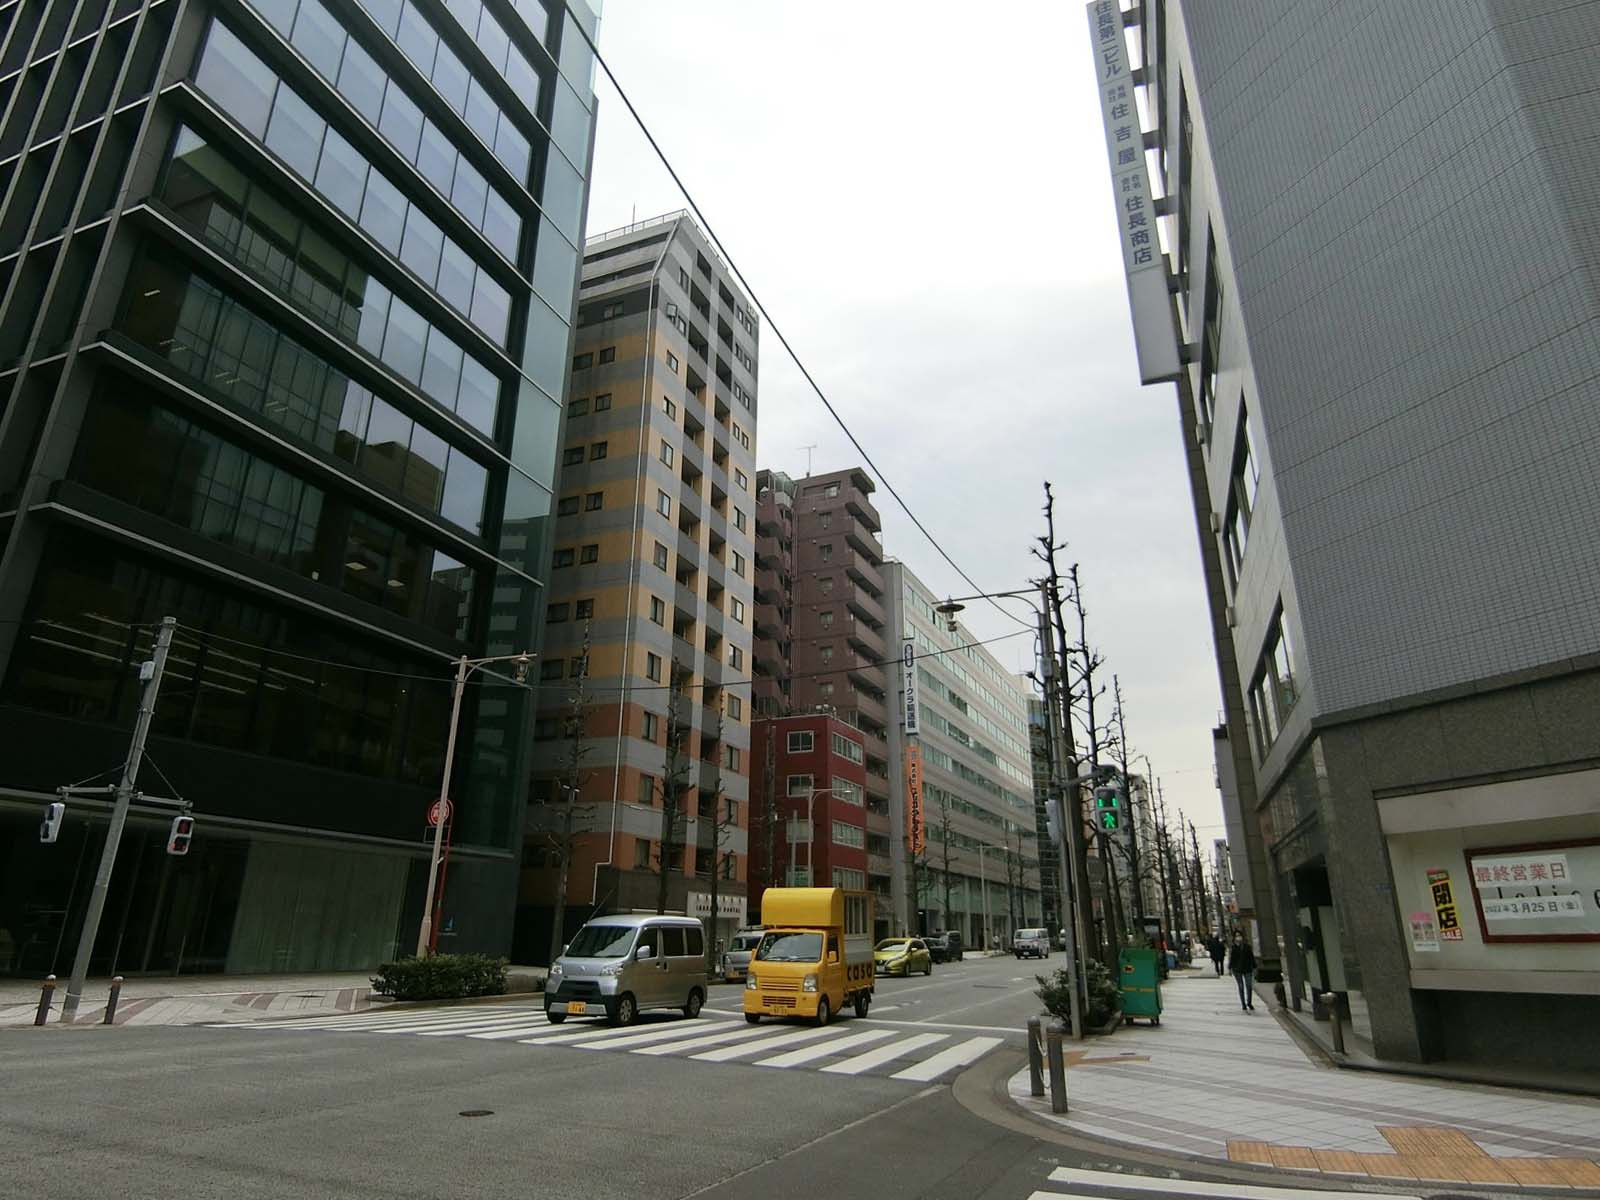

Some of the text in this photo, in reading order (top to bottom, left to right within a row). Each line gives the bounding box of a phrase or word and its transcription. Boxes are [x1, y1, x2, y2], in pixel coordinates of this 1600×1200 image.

[1111, 103, 1137, 166] 住吉屋
[1125, 195, 1152, 265] 住長商店
[1475, 862, 1566, 882] 最終営業日
[1432, 882, 1458, 930] 閉店
[847, 962, 872, 982] casa
